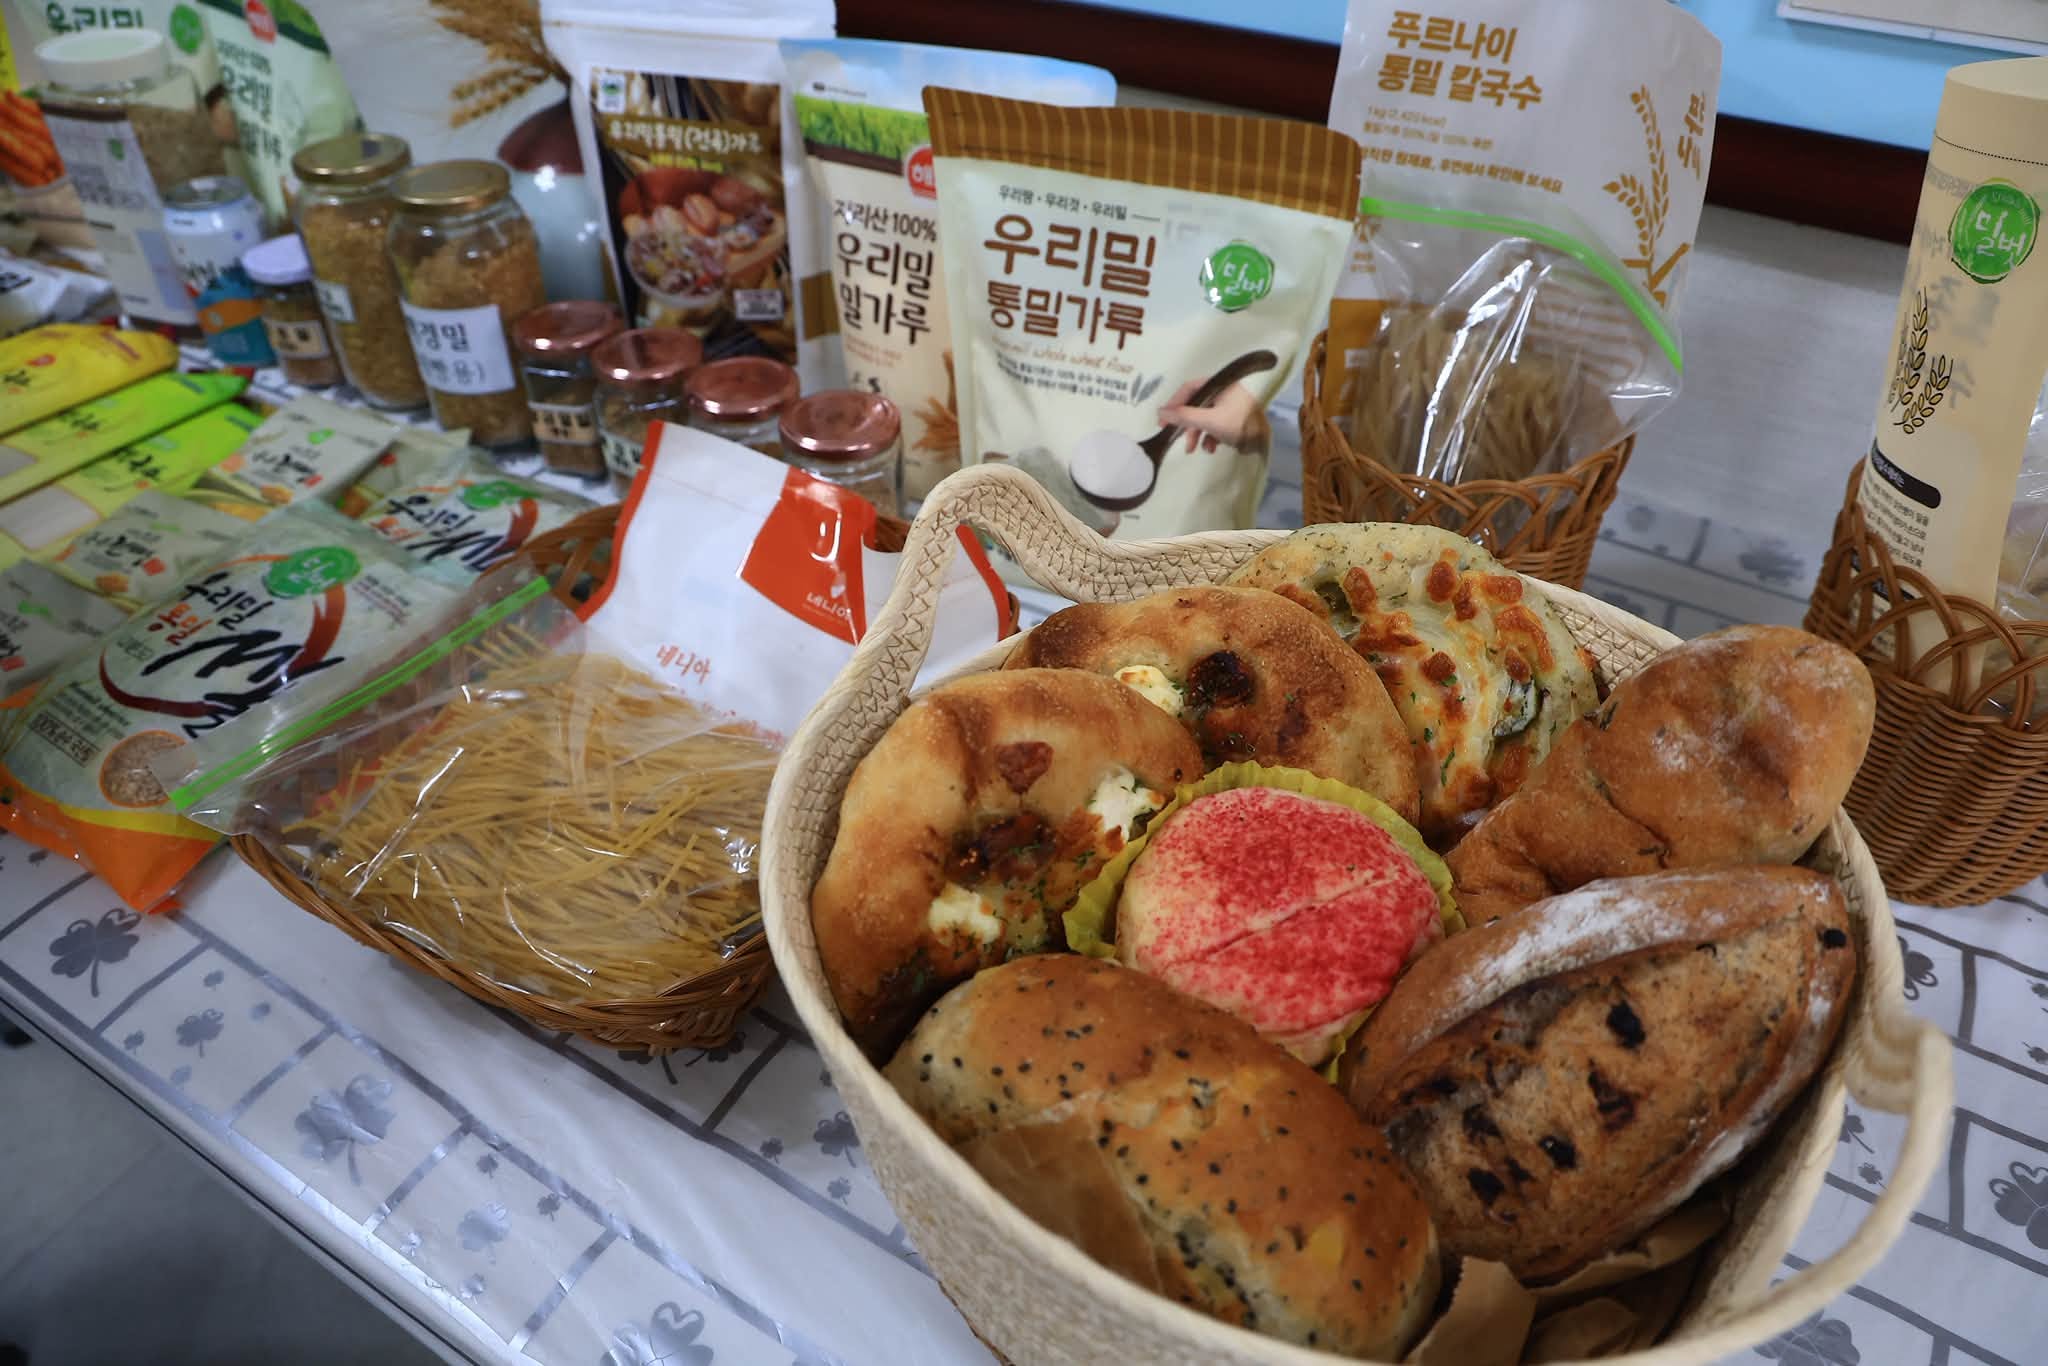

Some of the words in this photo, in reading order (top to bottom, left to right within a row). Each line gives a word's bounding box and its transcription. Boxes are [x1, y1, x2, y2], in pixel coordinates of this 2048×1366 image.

[1387, 10, 1518, 64] 푸르나이
[1377, 53, 1443, 98] 통밀
[1447, 64, 1543, 111] 칼국수
[838, 232, 934, 300] 우리밀
[984, 214, 1156, 298] 우리밀
[1975, 210, 2027, 272] 밀벗
[840, 282, 931, 345] 밀가루
[987, 280, 1145, 350] 통밀가루
[180, 571, 275, 630] 우리밀
[656, 644, 711, 685] 네니아
